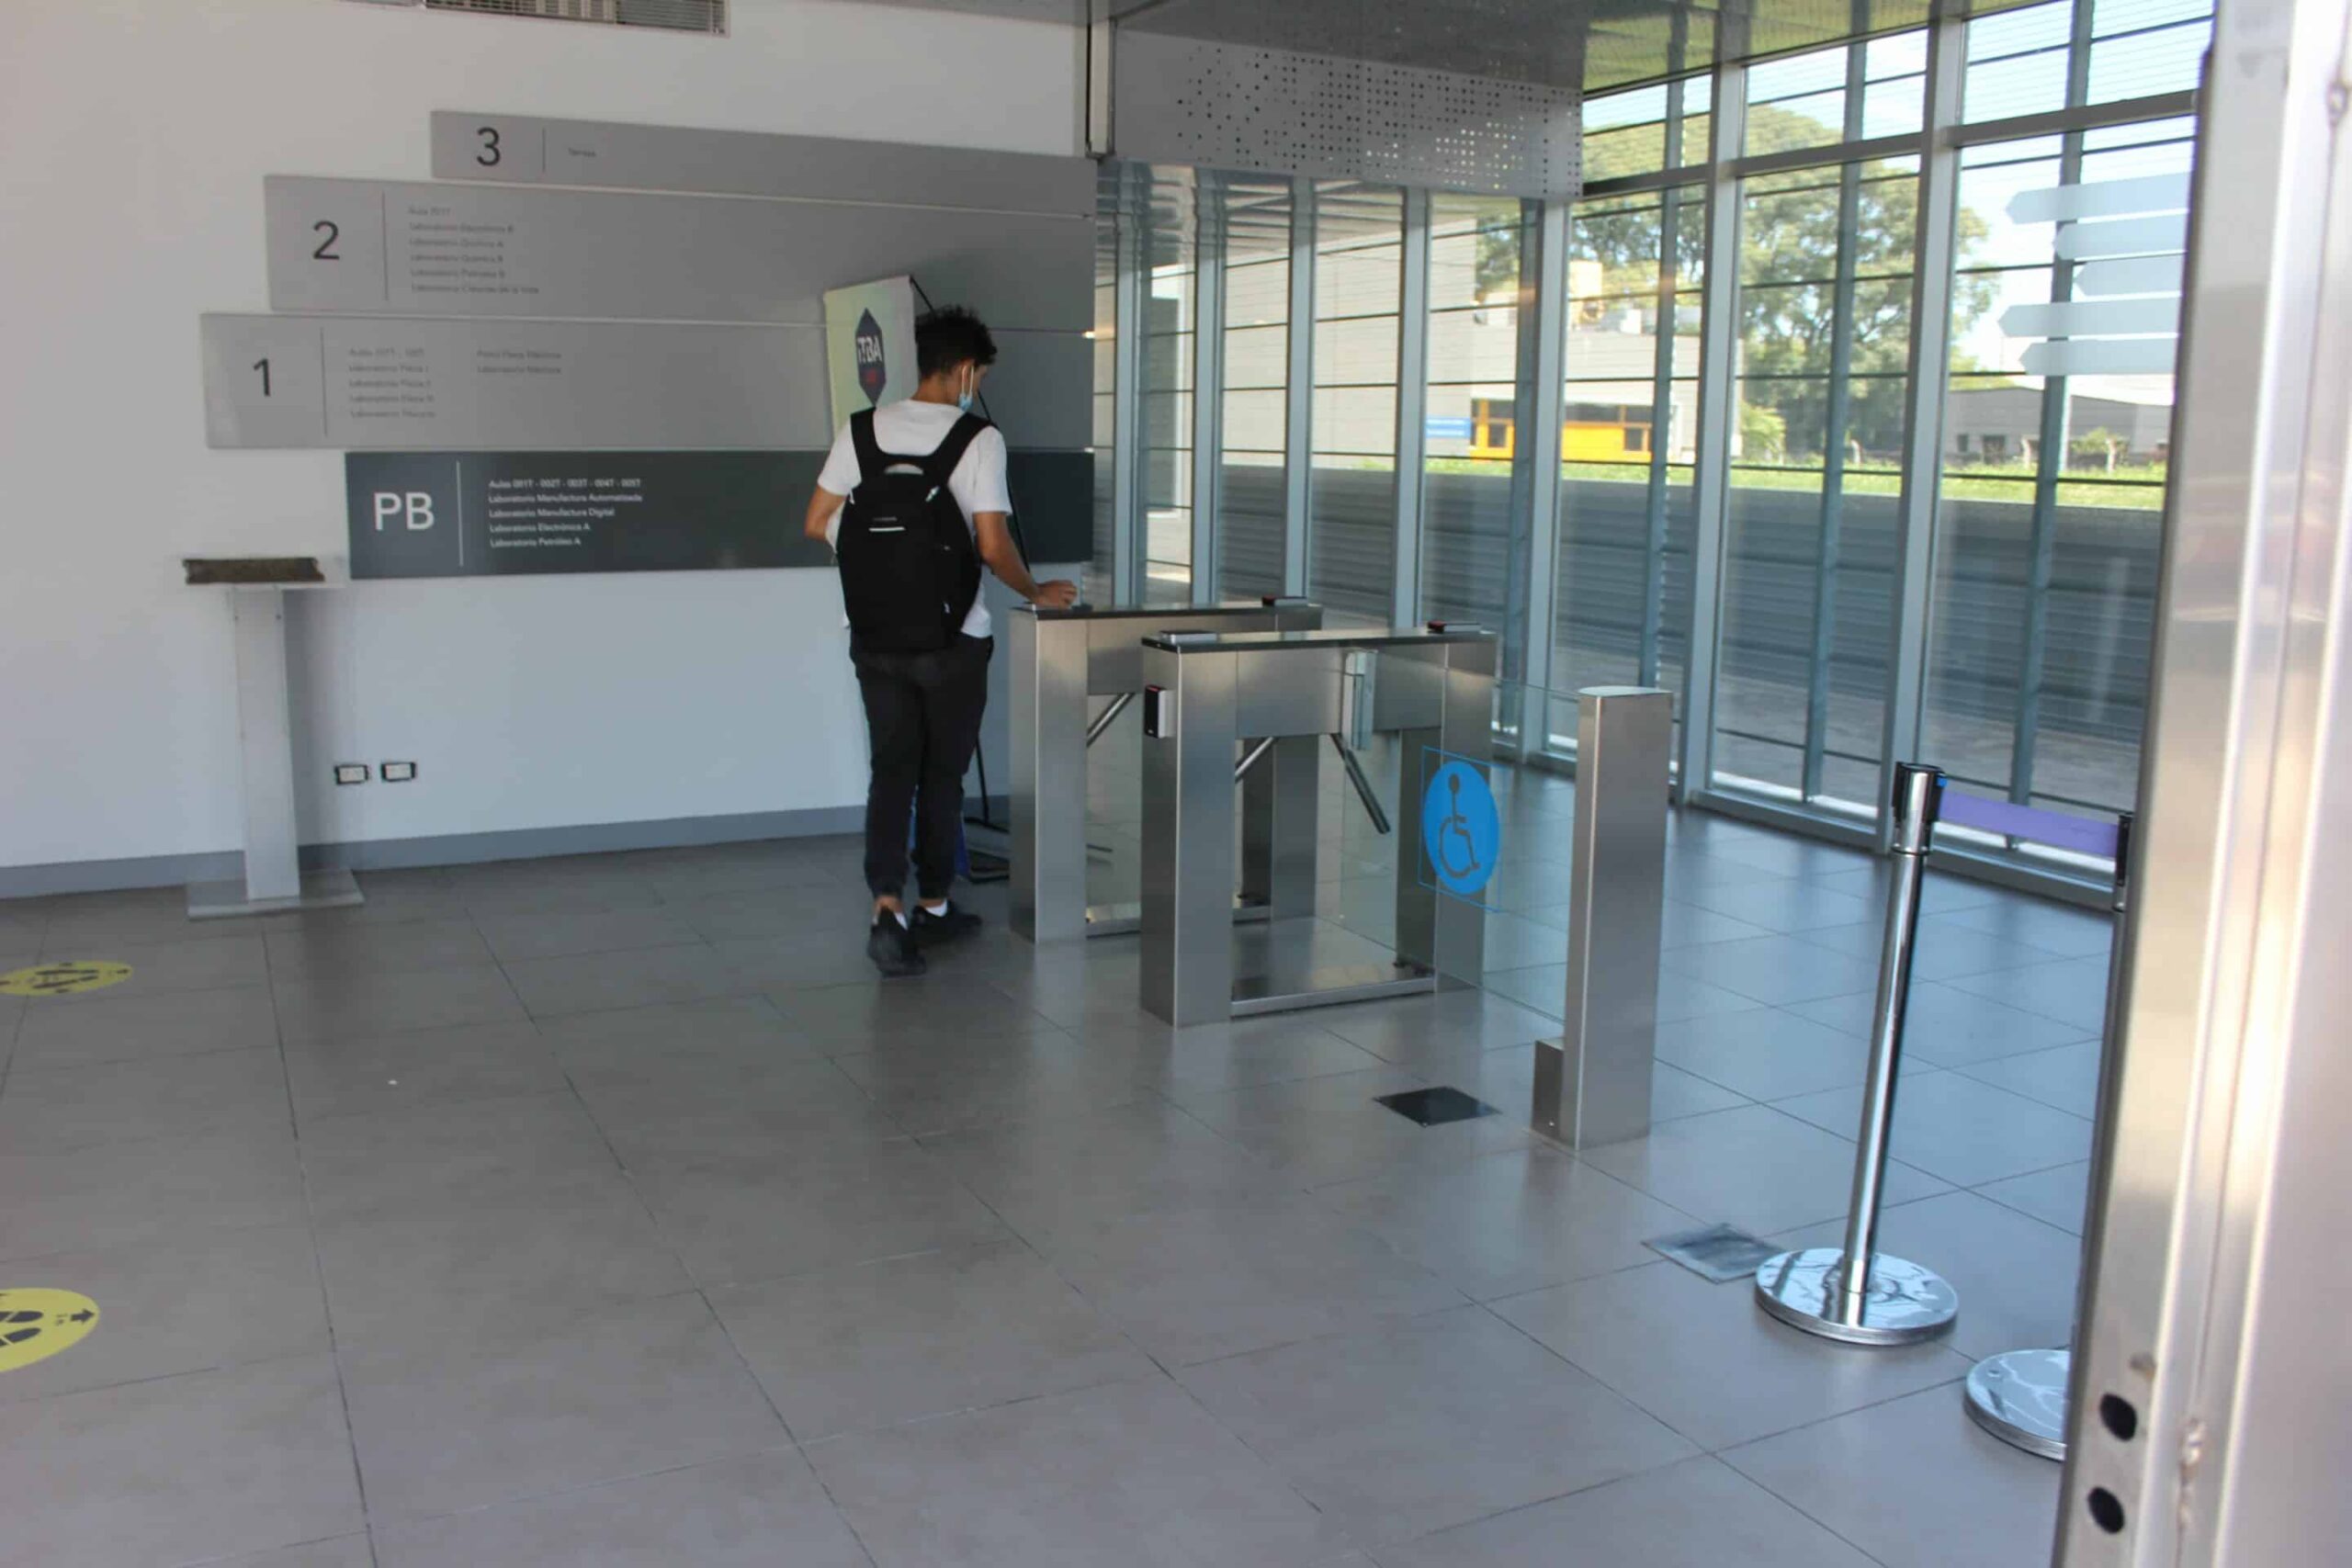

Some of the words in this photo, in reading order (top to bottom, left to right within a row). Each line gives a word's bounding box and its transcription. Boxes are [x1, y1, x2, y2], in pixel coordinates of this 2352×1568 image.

[477, 127, 501, 166] 3
[313, 220, 340, 260] 2
[253, 358, 271, 397] 1
[374, 491, 435, 530] PB
